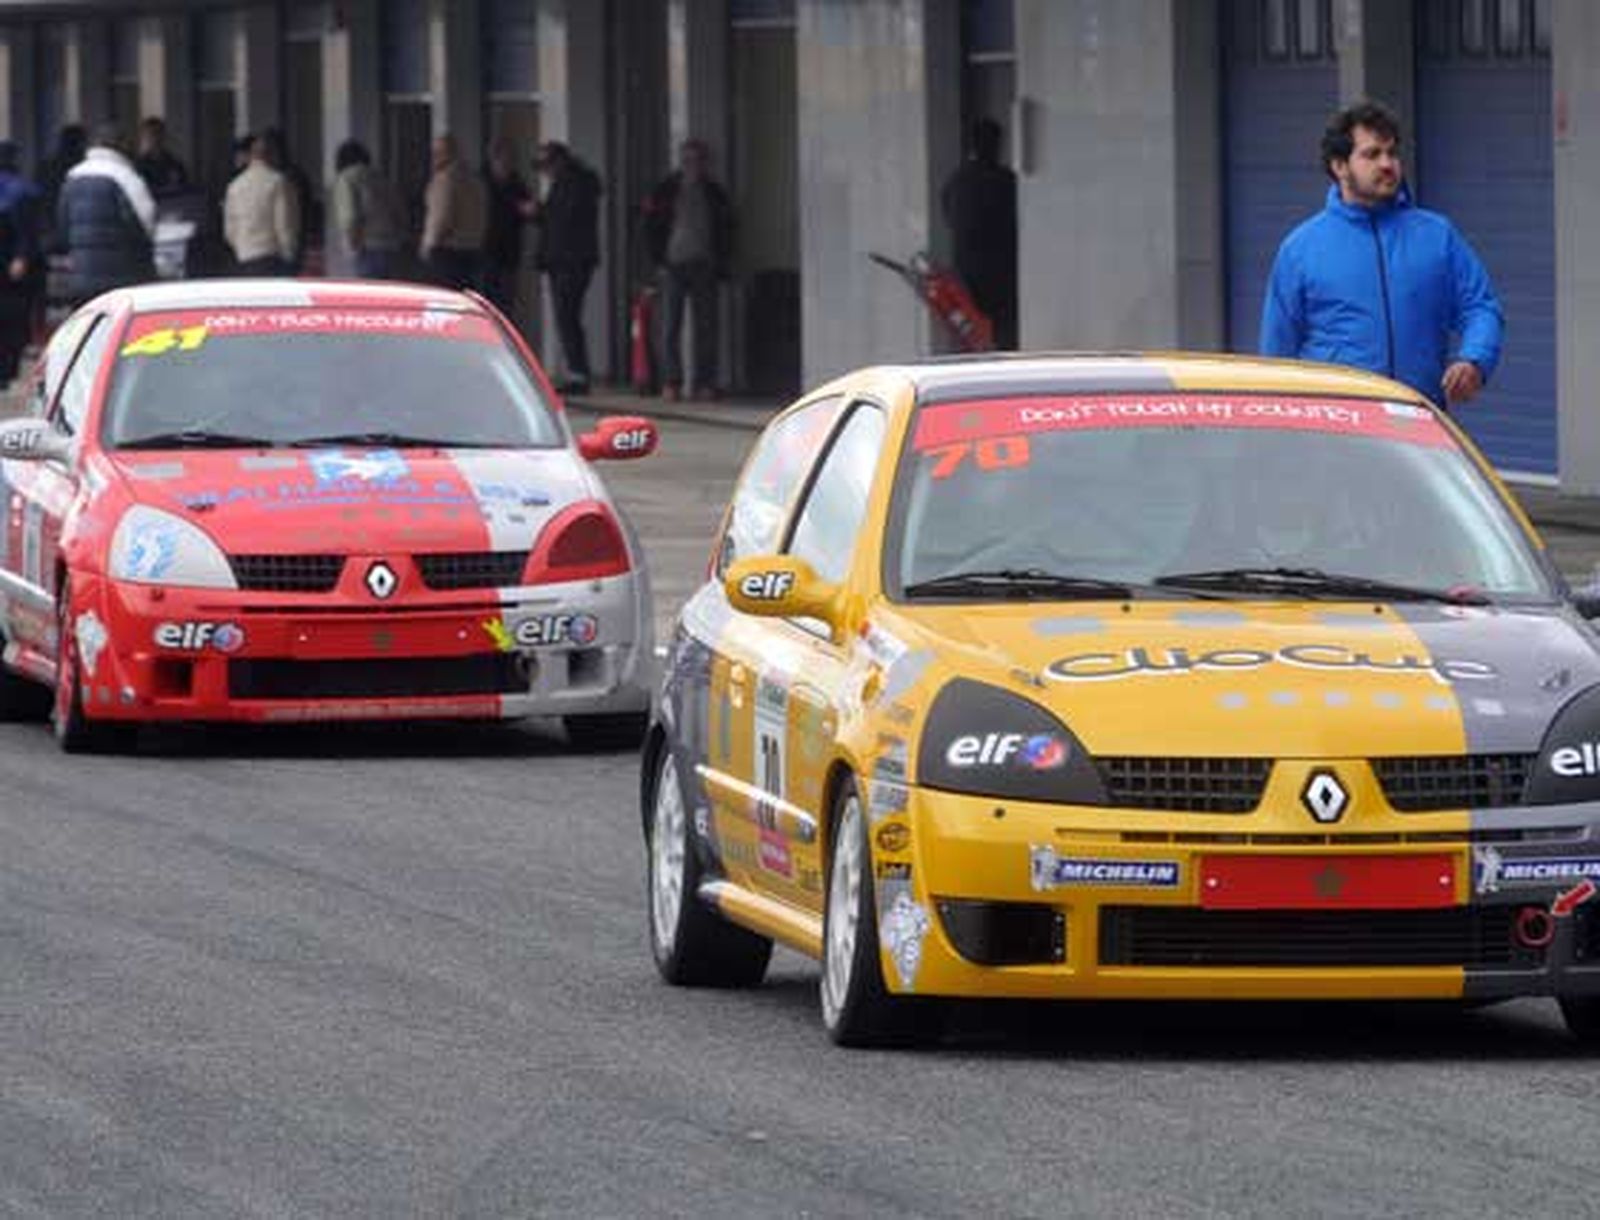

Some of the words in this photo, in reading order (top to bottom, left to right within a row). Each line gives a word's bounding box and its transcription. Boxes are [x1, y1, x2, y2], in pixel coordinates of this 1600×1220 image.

[120, 326, 208, 357] 41
[2, 427, 41, 451] elf
[612, 429, 651, 450] elf
[923, 437, 1031, 477] 70
[738, 572, 794, 599] elf
[154, 622, 215, 649] elf
[516, 615, 571, 643] elf
[946, 733, 1021, 765] elf
[1550, 742, 1600, 776] el
[1060, 863, 1176, 881] MICHELIN
